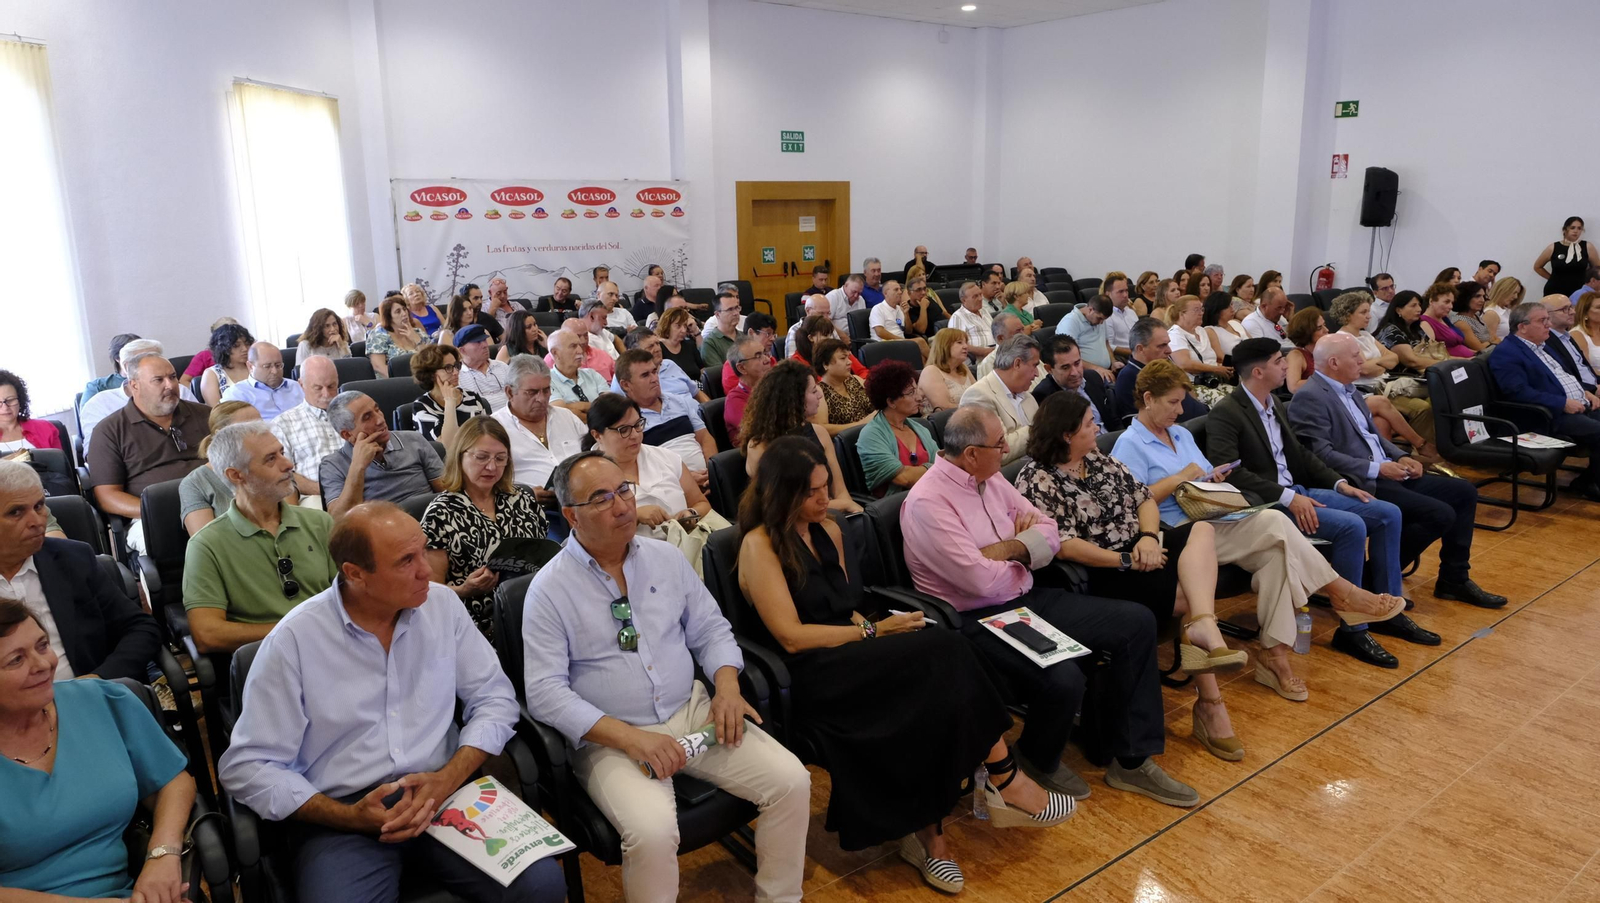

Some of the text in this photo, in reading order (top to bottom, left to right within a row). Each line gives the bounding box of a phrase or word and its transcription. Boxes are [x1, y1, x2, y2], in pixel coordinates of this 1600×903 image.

[782, 132, 803, 140] SALIDA
[782, 143, 803, 151] EXIT
[413, 191, 464, 202] VICASOL
[493, 191, 541, 202] VICASOL
[570, 191, 614, 201] VICASOL
[638, 191, 679, 201] VICASOL
[487, 244, 501, 253] Las
[502, 244, 526, 253] frutas
[533, 243, 567, 252] verduras
[568, 242, 595, 251] nacidas
[596, 242, 607, 250] del
